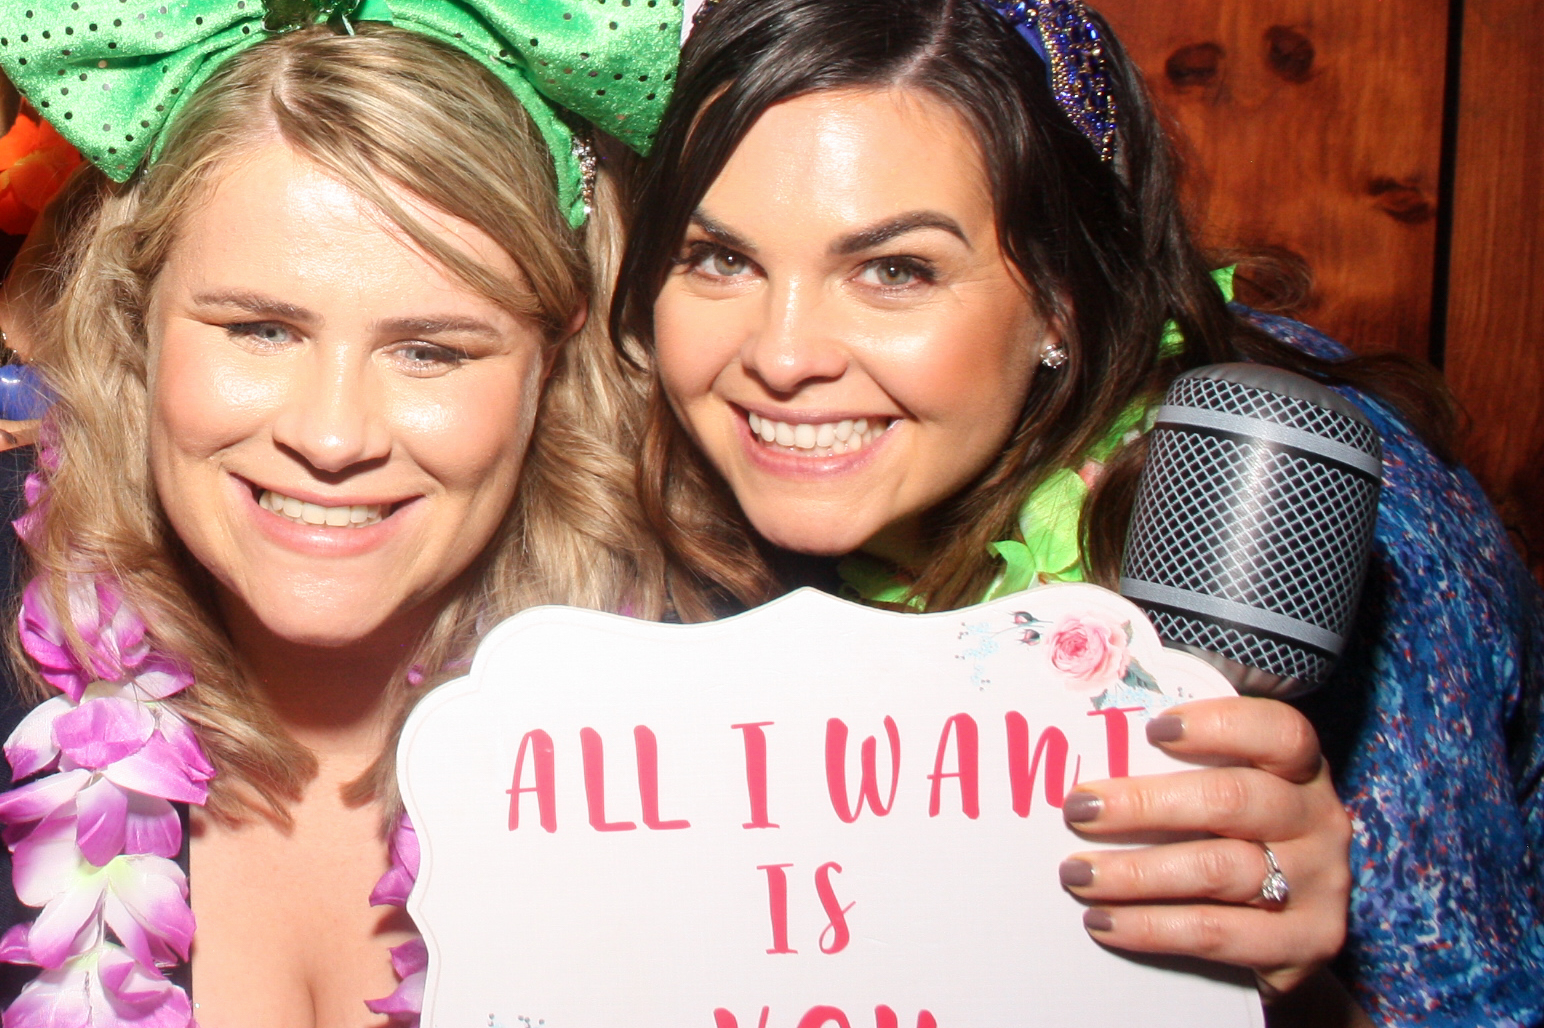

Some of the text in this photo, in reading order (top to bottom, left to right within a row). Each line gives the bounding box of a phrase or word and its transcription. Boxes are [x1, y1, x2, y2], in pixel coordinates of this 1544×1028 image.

[505, 726, 691, 834] ALL
[730, 720, 780, 829] I
[756, 861, 856, 954] IS
